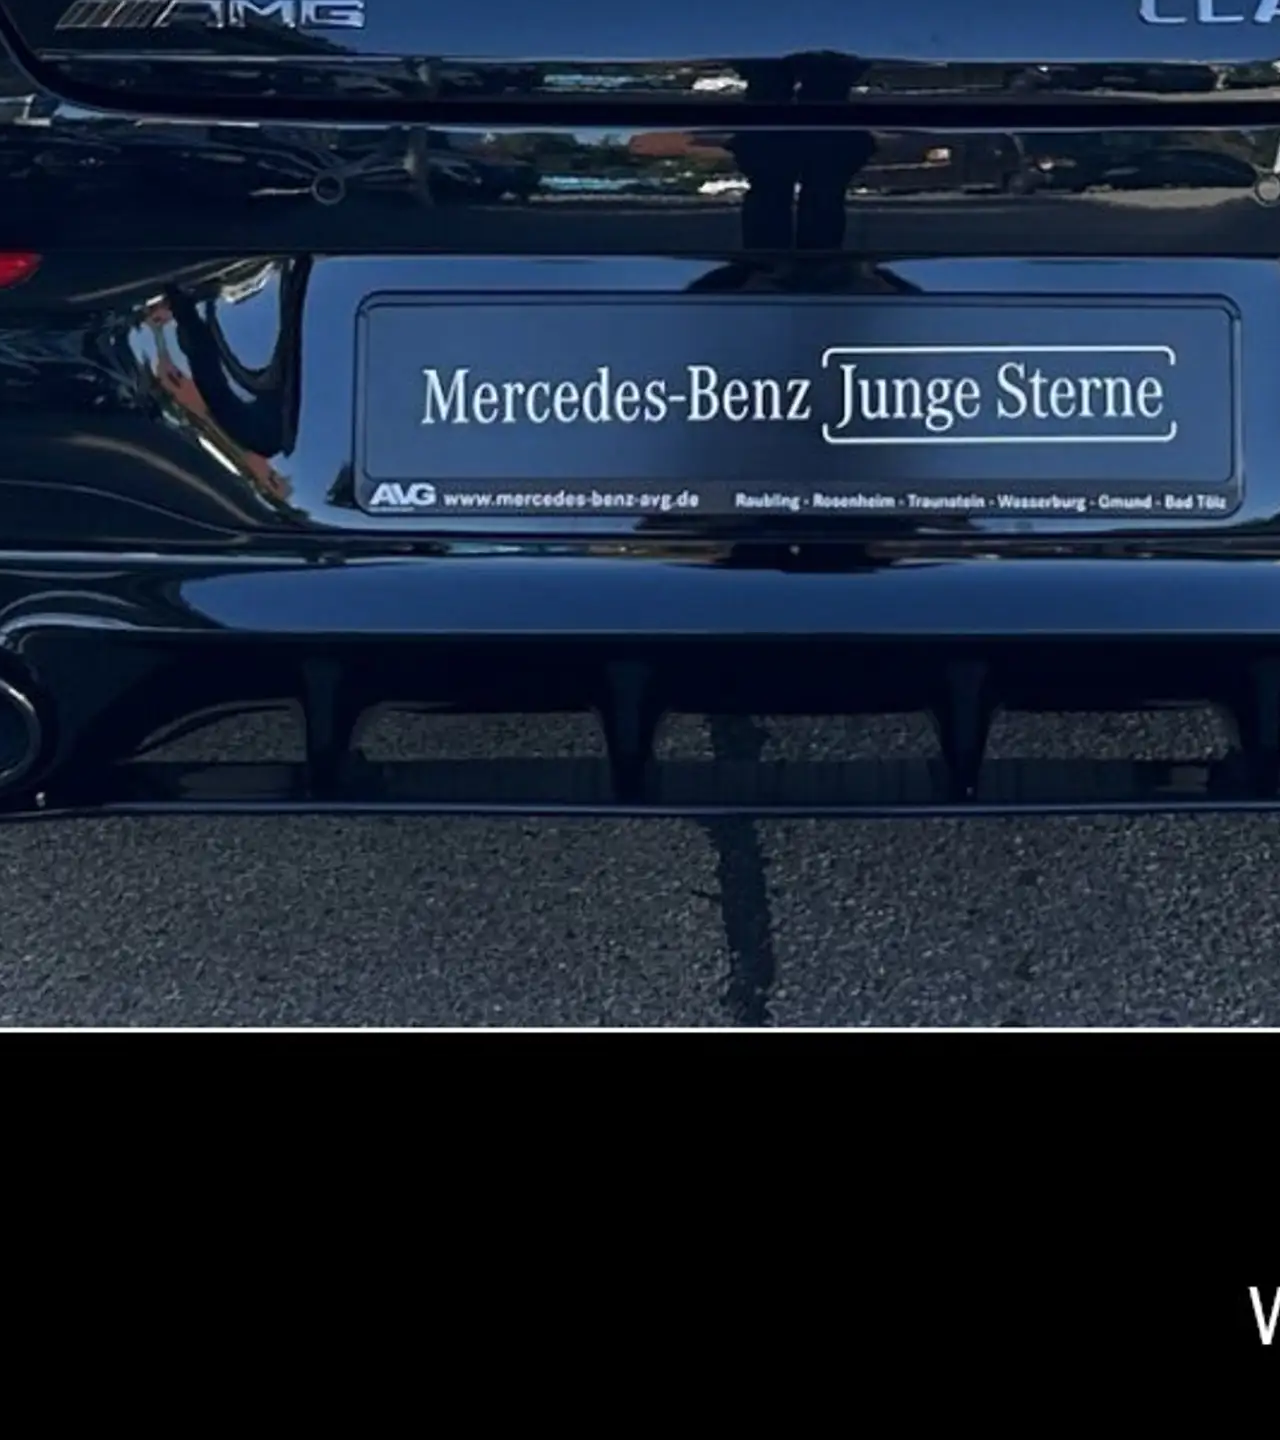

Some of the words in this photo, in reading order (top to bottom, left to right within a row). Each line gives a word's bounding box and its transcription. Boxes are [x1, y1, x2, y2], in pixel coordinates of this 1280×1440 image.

[421, 365, 811, 425] Mercedes-Benz
[836, 364, 981, 432] Junge
[996, 362, 1164, 419] Sterne
[369, 482, 437, 507] AVG
[443, 489, 700, 512] www.mercedes-benz-avg.de
[735, 492, 800, 511] Raubling
[812, 492, 896, 508] Rosenheim
[907, 493, 986, 509] Traunstein
[997, 493, 1087, 512] Wasserburg
[1098, 493, 1153, 509] Gmund
[1164, 494, 1193, 509] Bad
